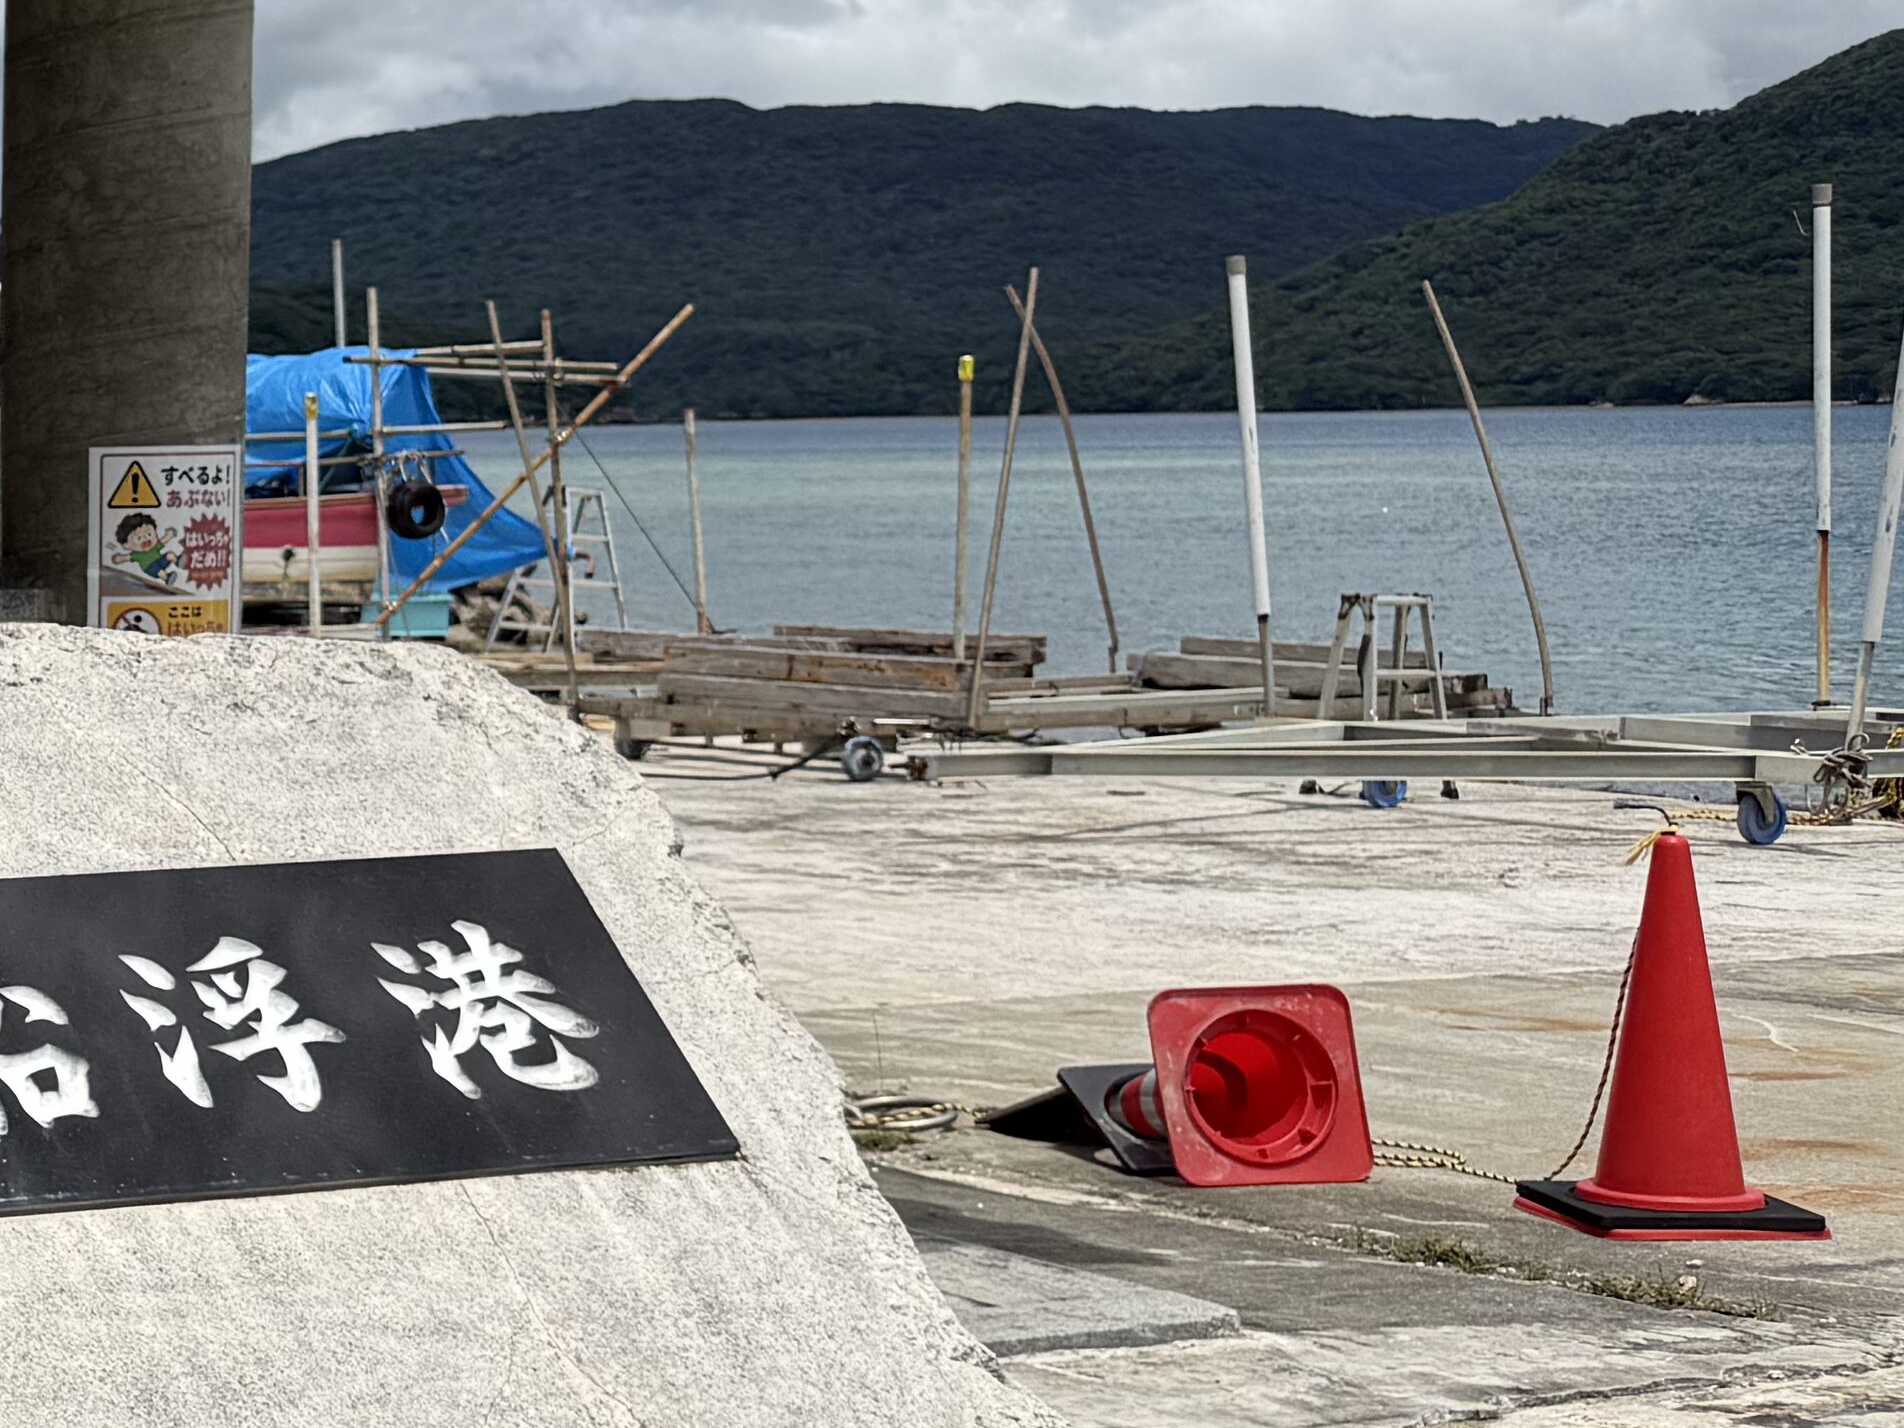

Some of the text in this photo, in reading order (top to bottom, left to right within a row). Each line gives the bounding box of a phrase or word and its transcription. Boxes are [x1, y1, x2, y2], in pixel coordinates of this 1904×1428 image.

[161, 465, 230, 486] すべるよ！
[166, 489, 231, 508] あぶない！
[168, 605, 202, 618] ここは
